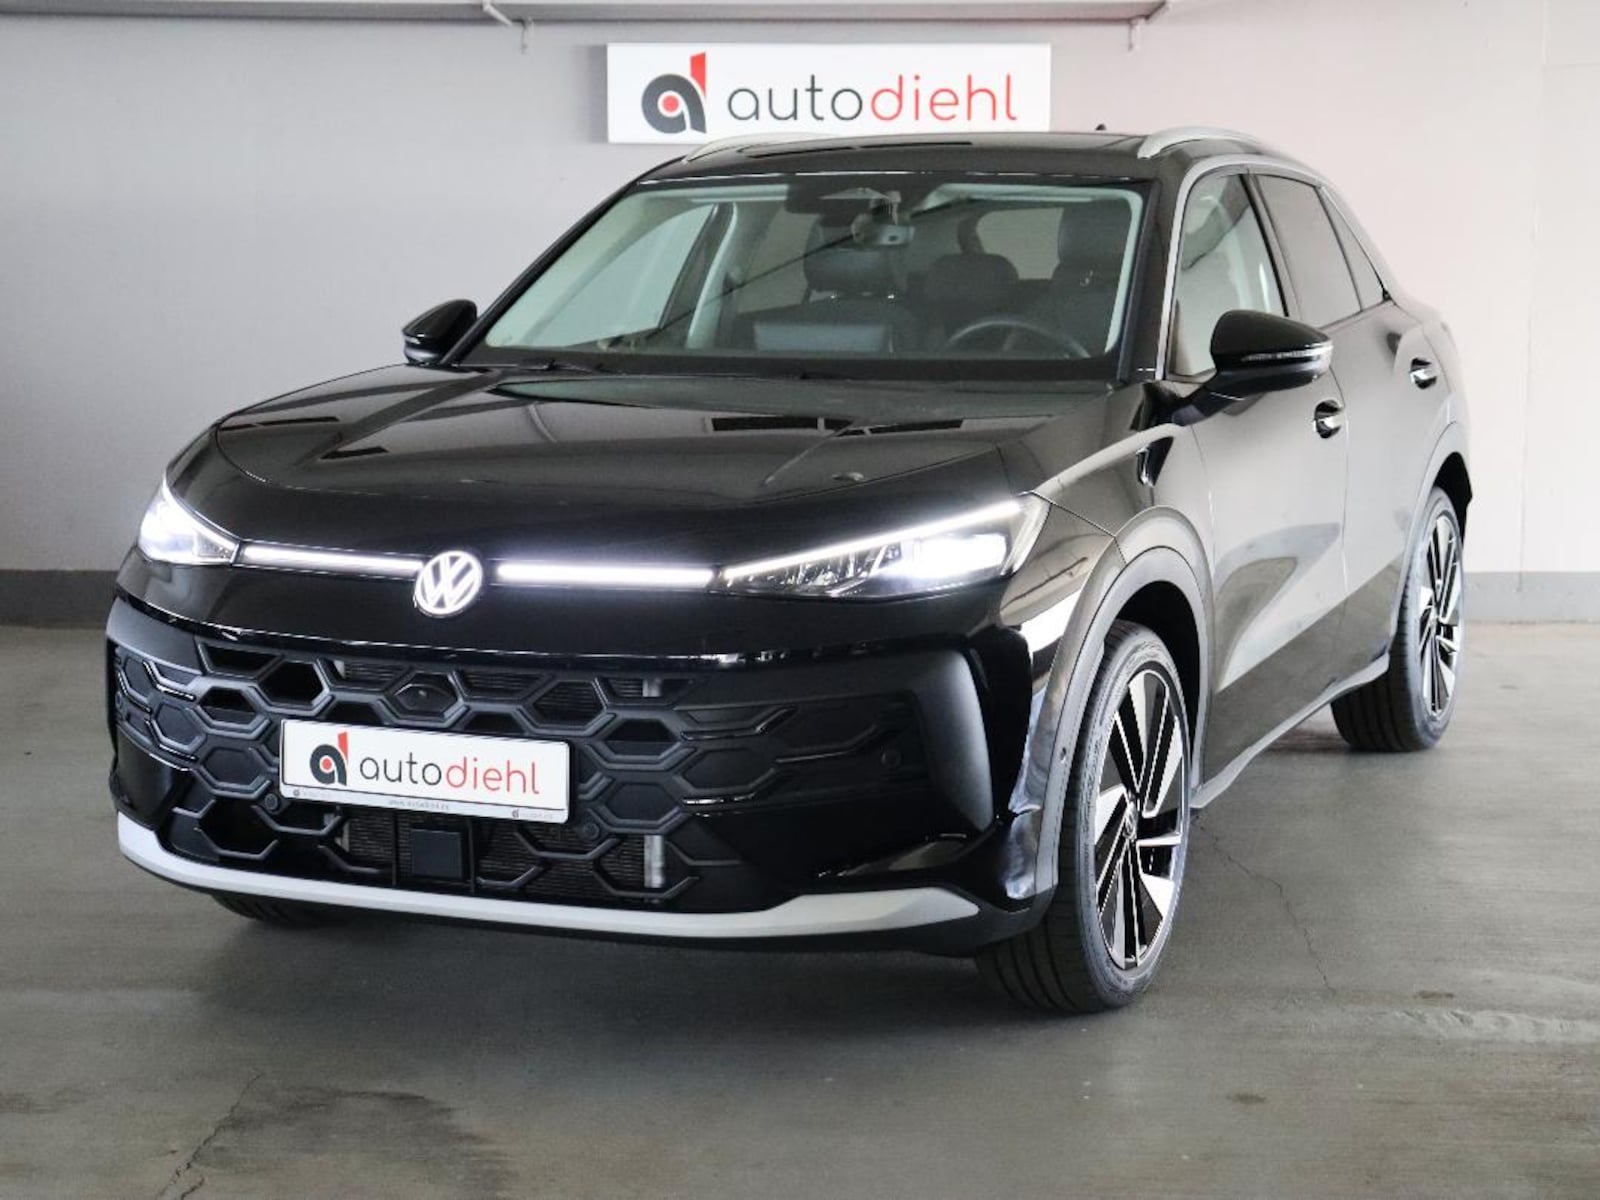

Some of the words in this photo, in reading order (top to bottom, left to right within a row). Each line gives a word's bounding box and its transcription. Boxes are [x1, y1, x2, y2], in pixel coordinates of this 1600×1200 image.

[727, 74, 1018, 121] autodiehl
[414, 550, 483, 617] VW
[359, 752, 540, 795] autodiehl
